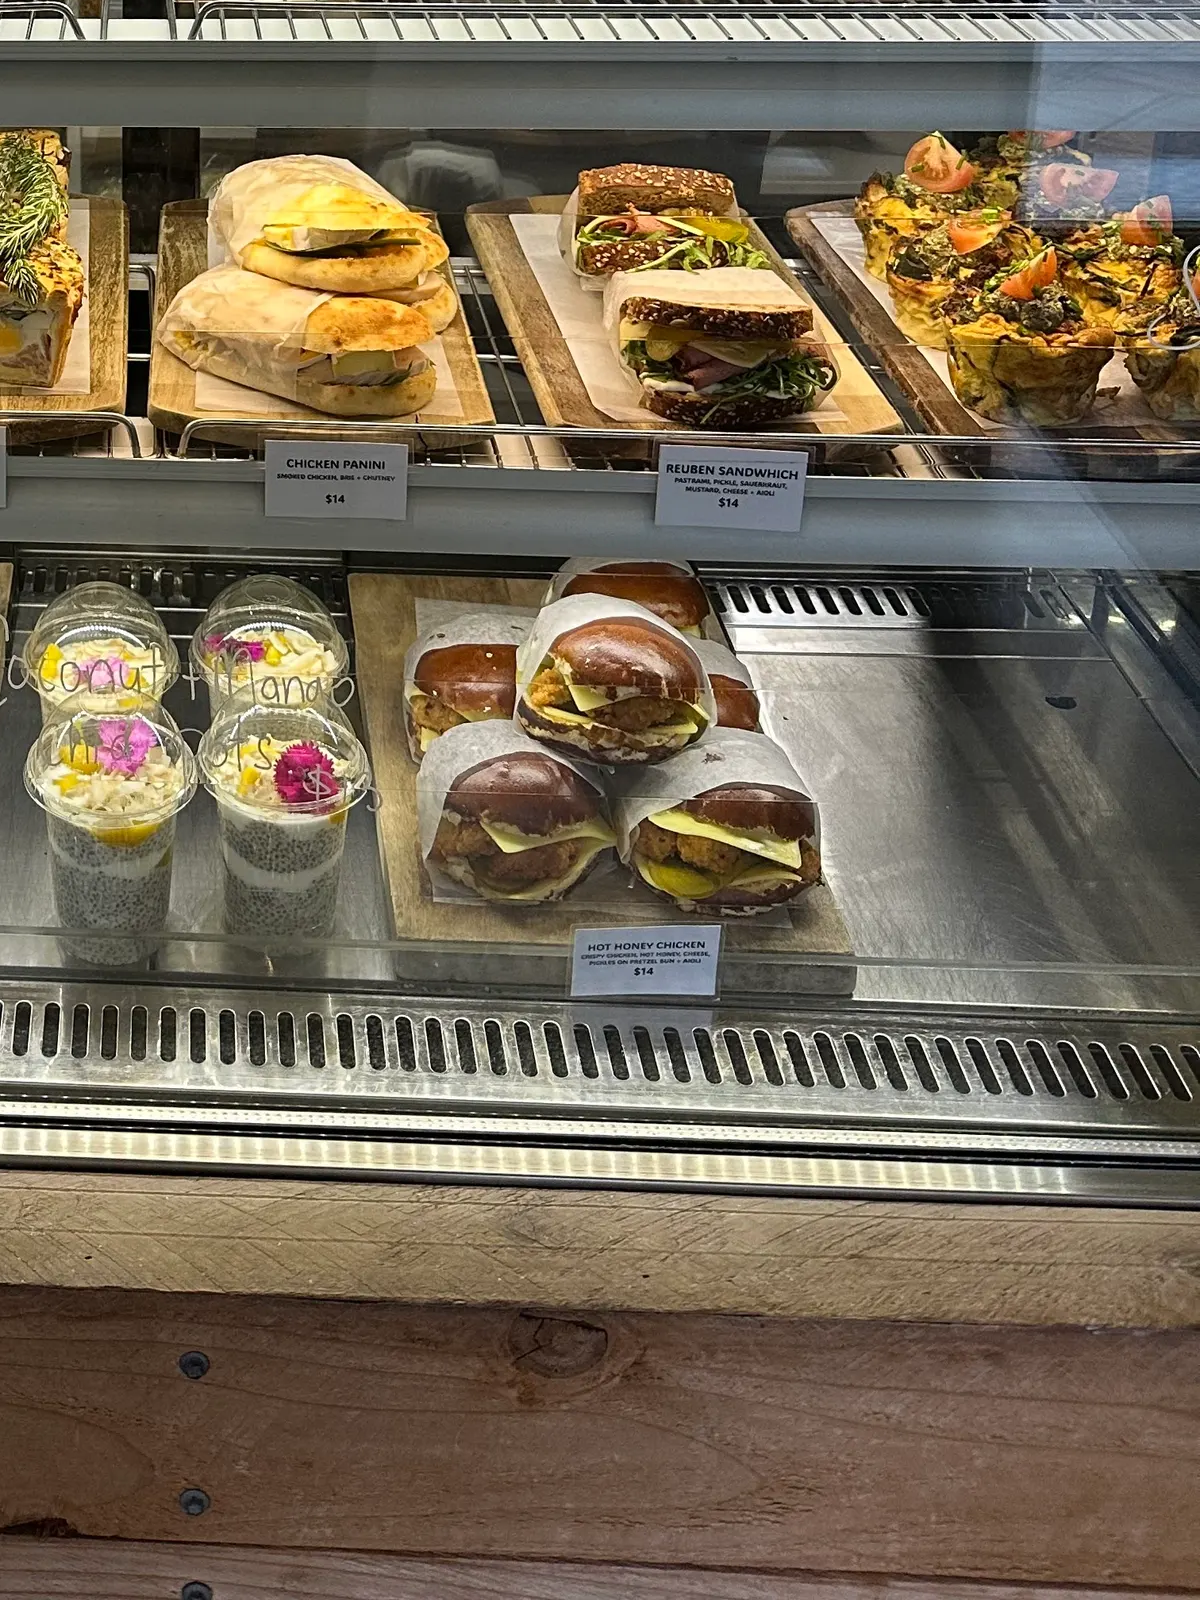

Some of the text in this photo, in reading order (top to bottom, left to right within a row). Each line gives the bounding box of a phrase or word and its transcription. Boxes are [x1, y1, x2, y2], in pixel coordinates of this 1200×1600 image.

[286, 458, 386, 470] CHICKEN PANINI
[666, 463, 800, 481] REUBEN SANDWHICH
[713, 479, 738, 487] PICKLE,
[685, 486, 721, 494] MUSTARD,
[722, 487, 748, 496] CHEESE
[756, 489, 775, 497] AIOLI
[325, 494, 345, 505] $14
[718, 497, 739, 508] $14
[181, 664, 199, 701] +
[588, 941, 706, 952] HOT HONEY CHICKEN
[580, 952, 605, 960] CRISPY
[633, 967, 654, 976] $14
